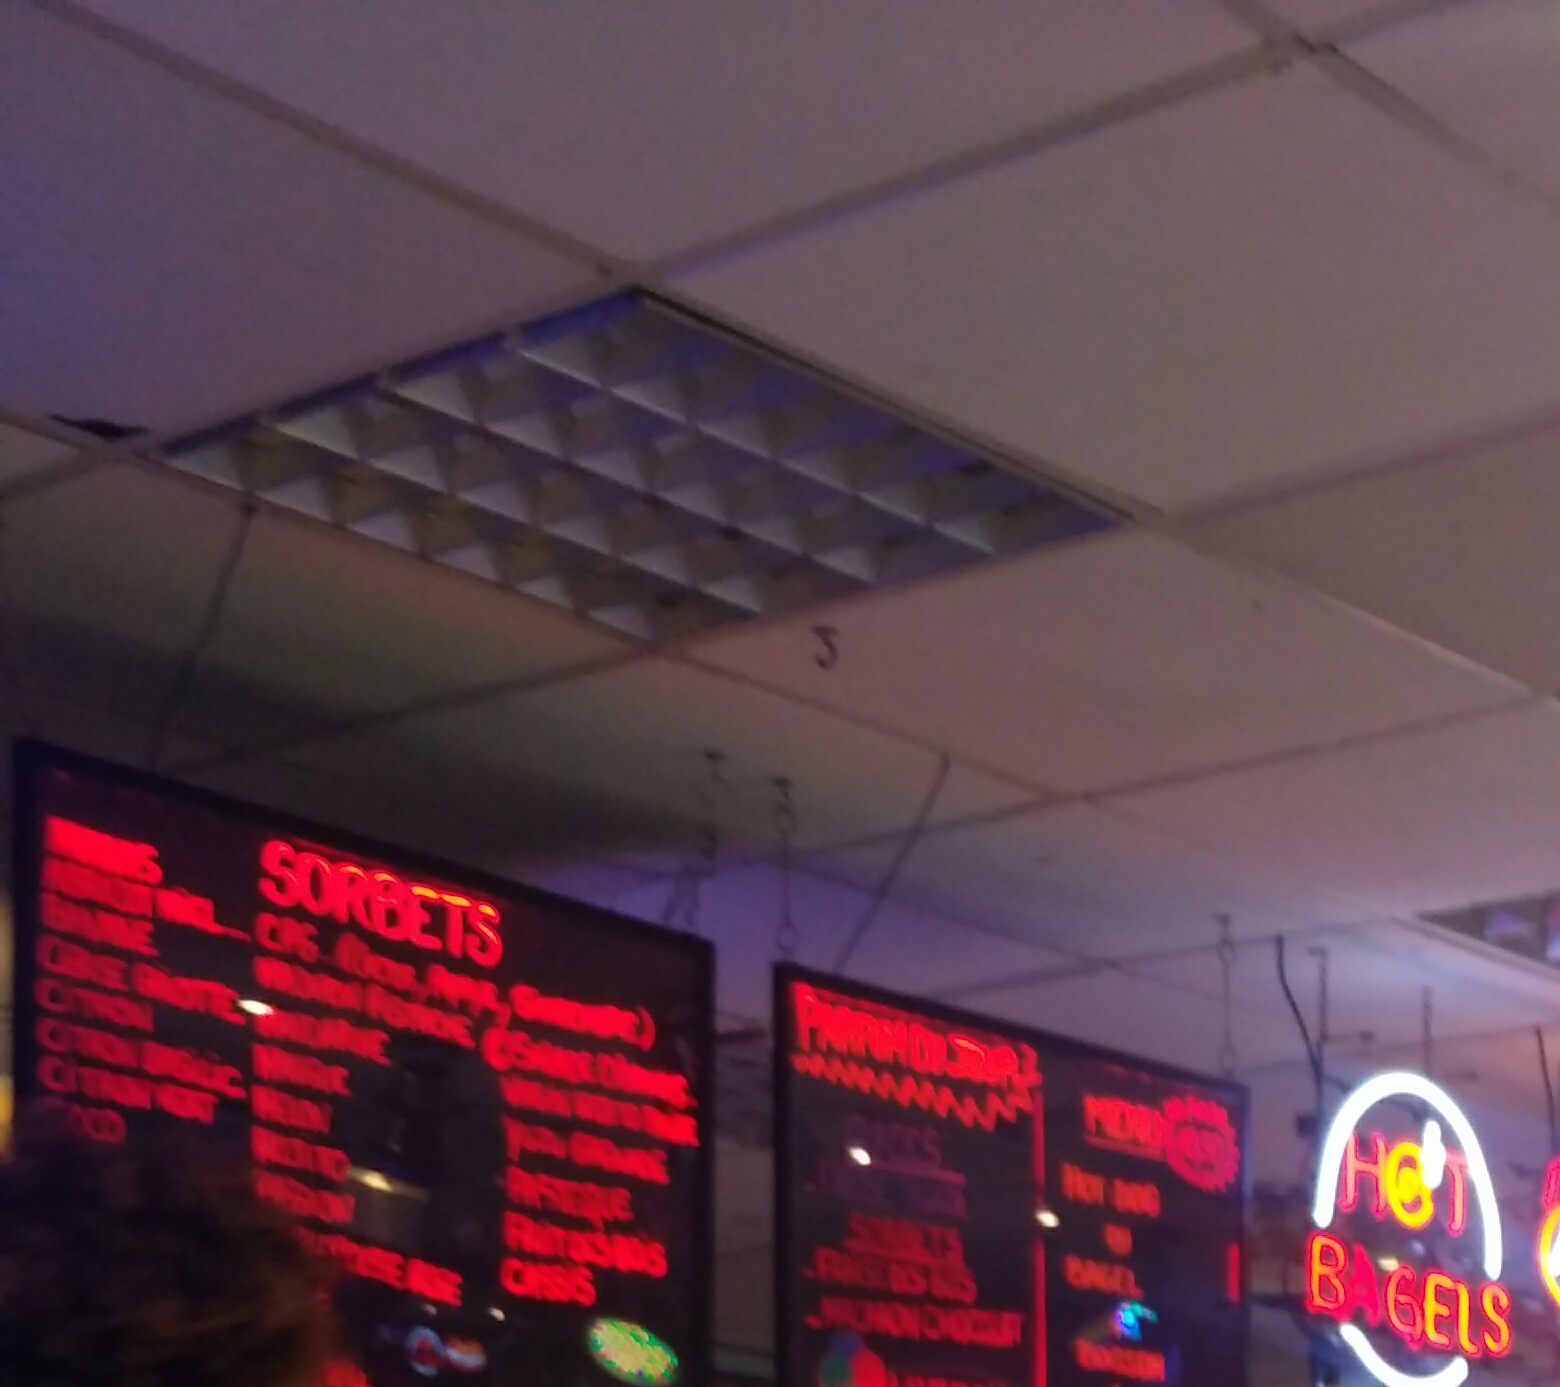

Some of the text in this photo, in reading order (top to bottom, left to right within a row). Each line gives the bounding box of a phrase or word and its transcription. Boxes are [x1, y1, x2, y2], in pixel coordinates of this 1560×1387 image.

[258, 839, 503, 968] SORBETS
[1337, 1131, 1470, 1237] HOT
[1307, 1232, 1512, 1357] BAGELS
